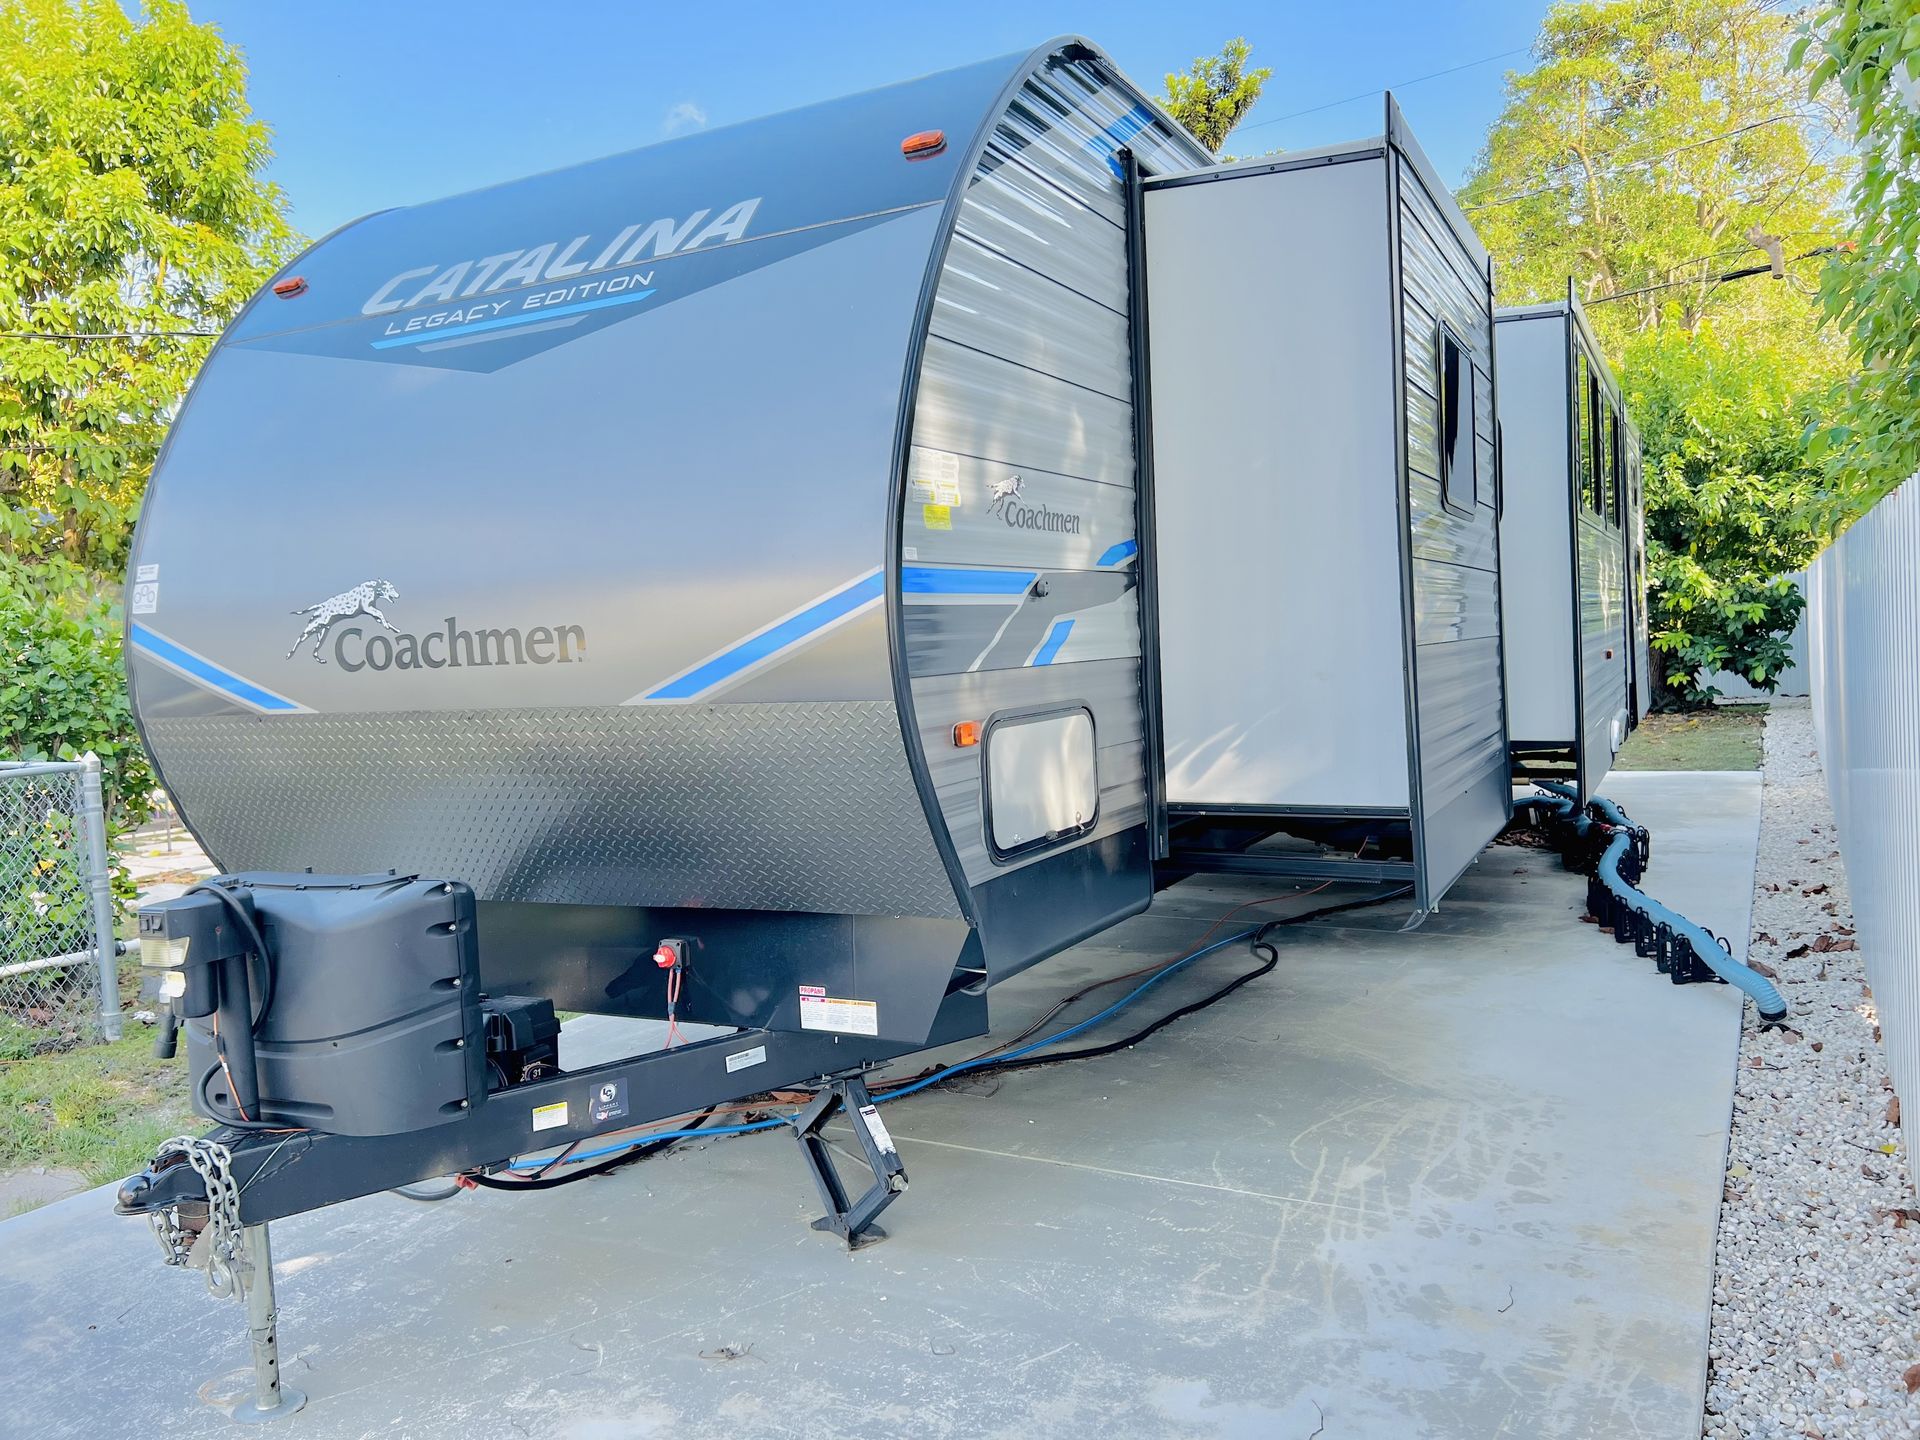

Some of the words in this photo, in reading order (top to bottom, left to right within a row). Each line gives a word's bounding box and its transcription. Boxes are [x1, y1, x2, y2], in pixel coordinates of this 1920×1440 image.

[361, 197, 763, 316] CATALINA
[384, 300, 511, 336] LEGACY
[521, 270, 655, 310] EDITION
[1004, 501, 1080, 534] Coachmen
[334, 616, 587, 672] Coachmen
[801, 987, 824, 995] PROPANE
